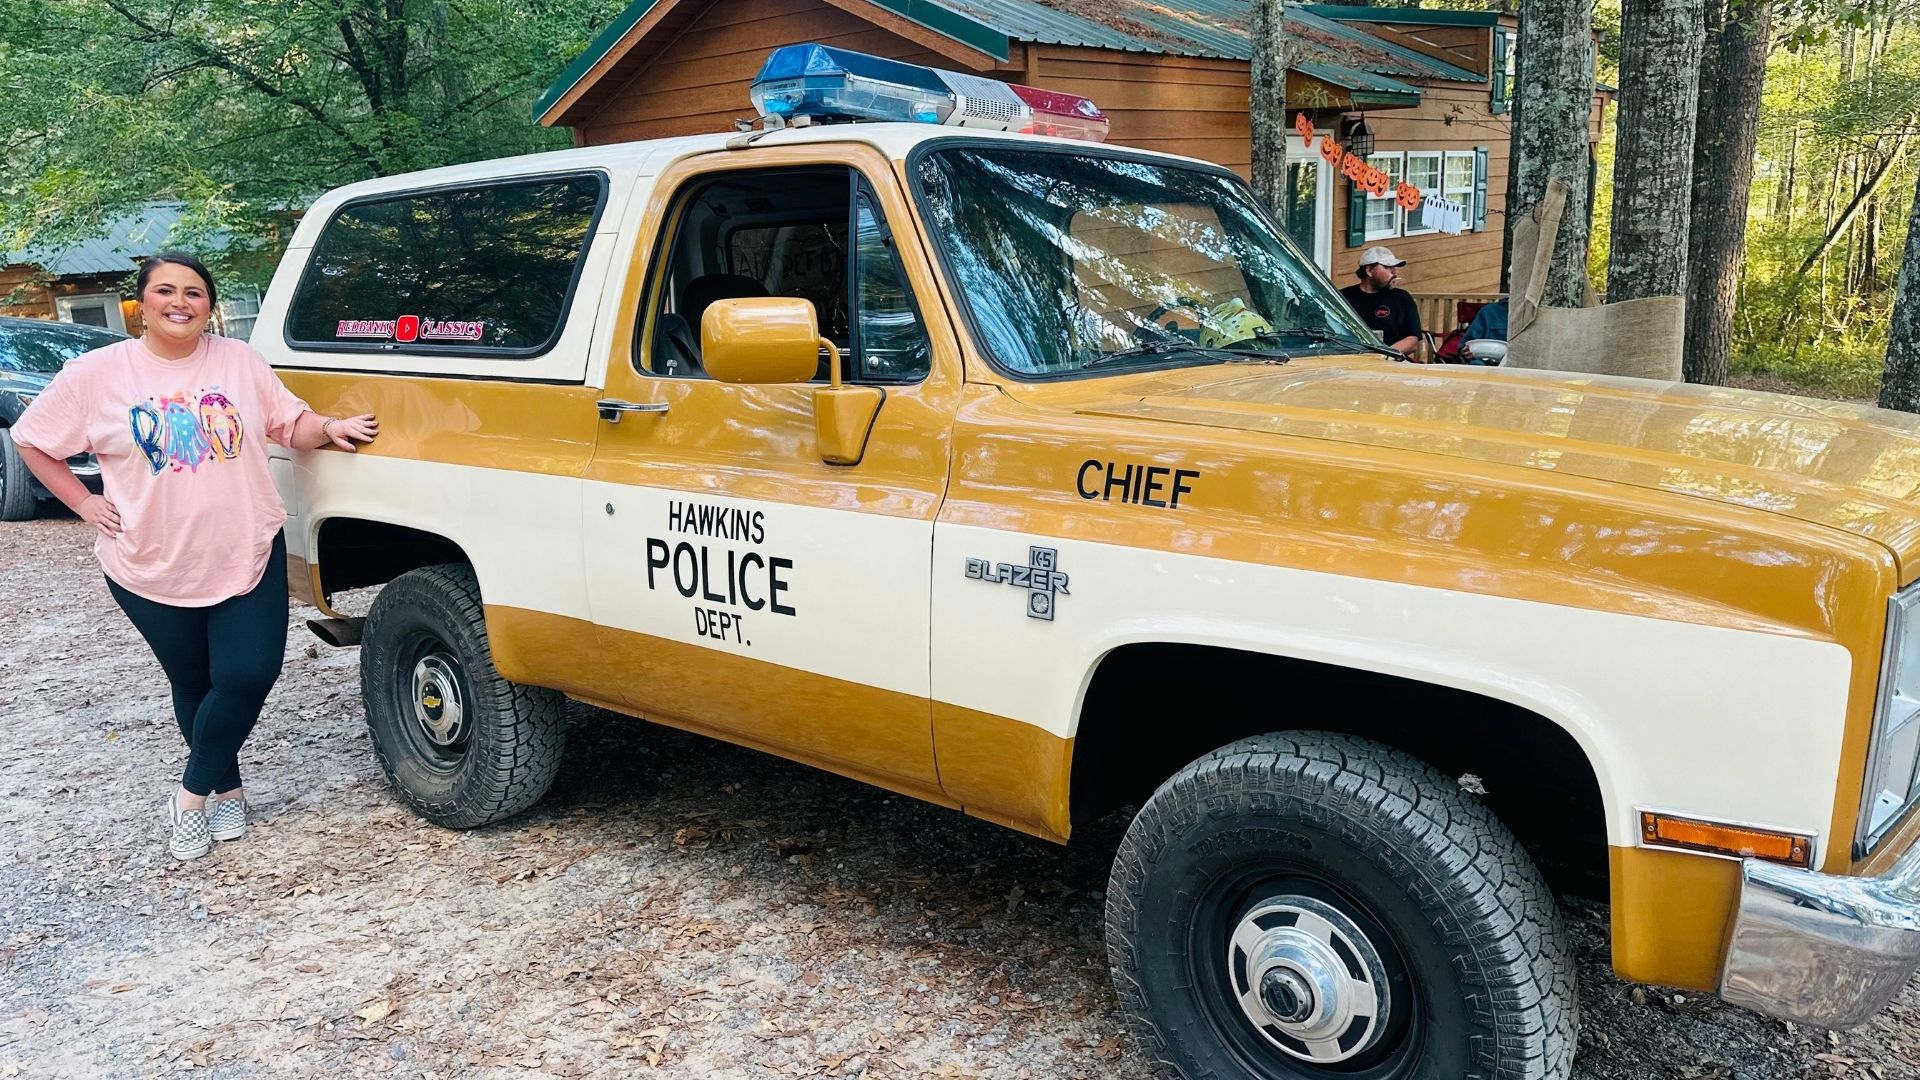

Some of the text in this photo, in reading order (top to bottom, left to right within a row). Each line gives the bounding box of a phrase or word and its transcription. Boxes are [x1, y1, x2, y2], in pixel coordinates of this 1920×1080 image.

[336, 320, 484, 341] REDBANKS CLASSICS
[1076, 459, 1200, 510] CHIEF
[669, 500, 765, 545] HAWKINS
[646, 537, 796, 617] POLICE
[965, 556, 1071, 595] BLAZER
[694, 606, 752, 647] DEPT.
